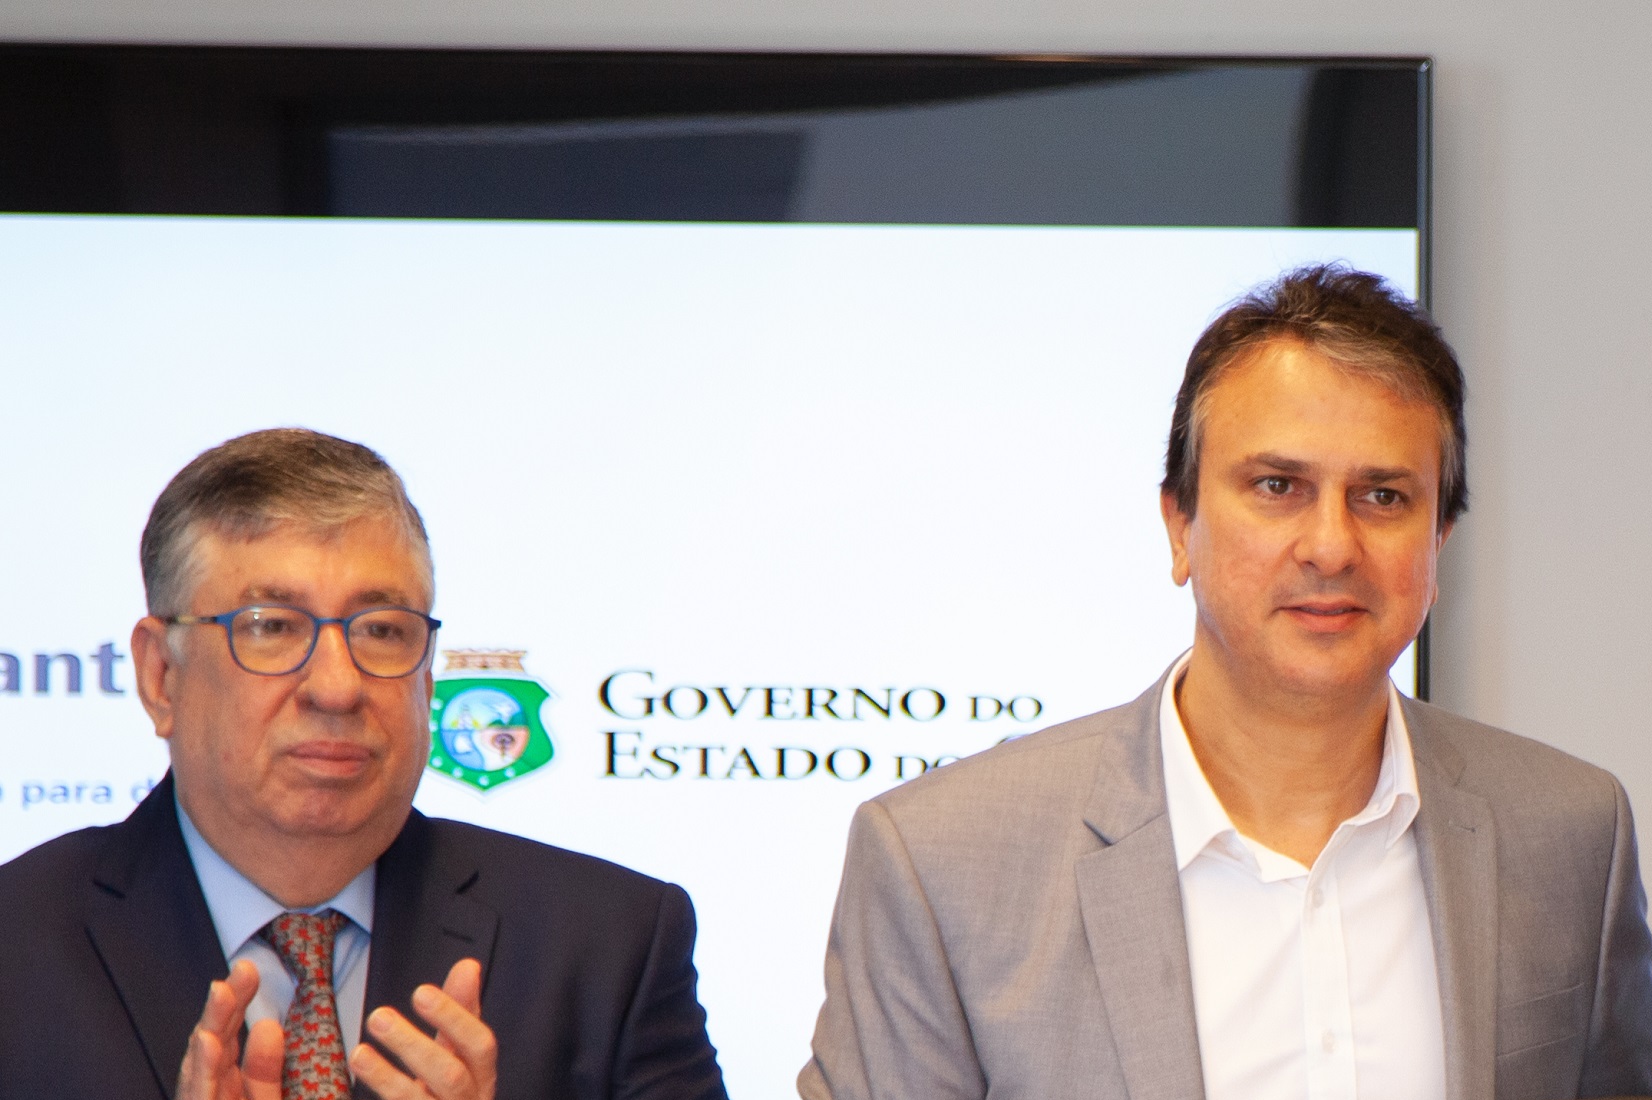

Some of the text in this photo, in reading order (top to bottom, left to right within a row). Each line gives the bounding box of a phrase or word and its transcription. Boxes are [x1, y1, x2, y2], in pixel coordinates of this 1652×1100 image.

[598, 668, 947, 722] GOVERNO
[600, 730, 873, 781] ESTADO
[22, 783, 113, 810] para
